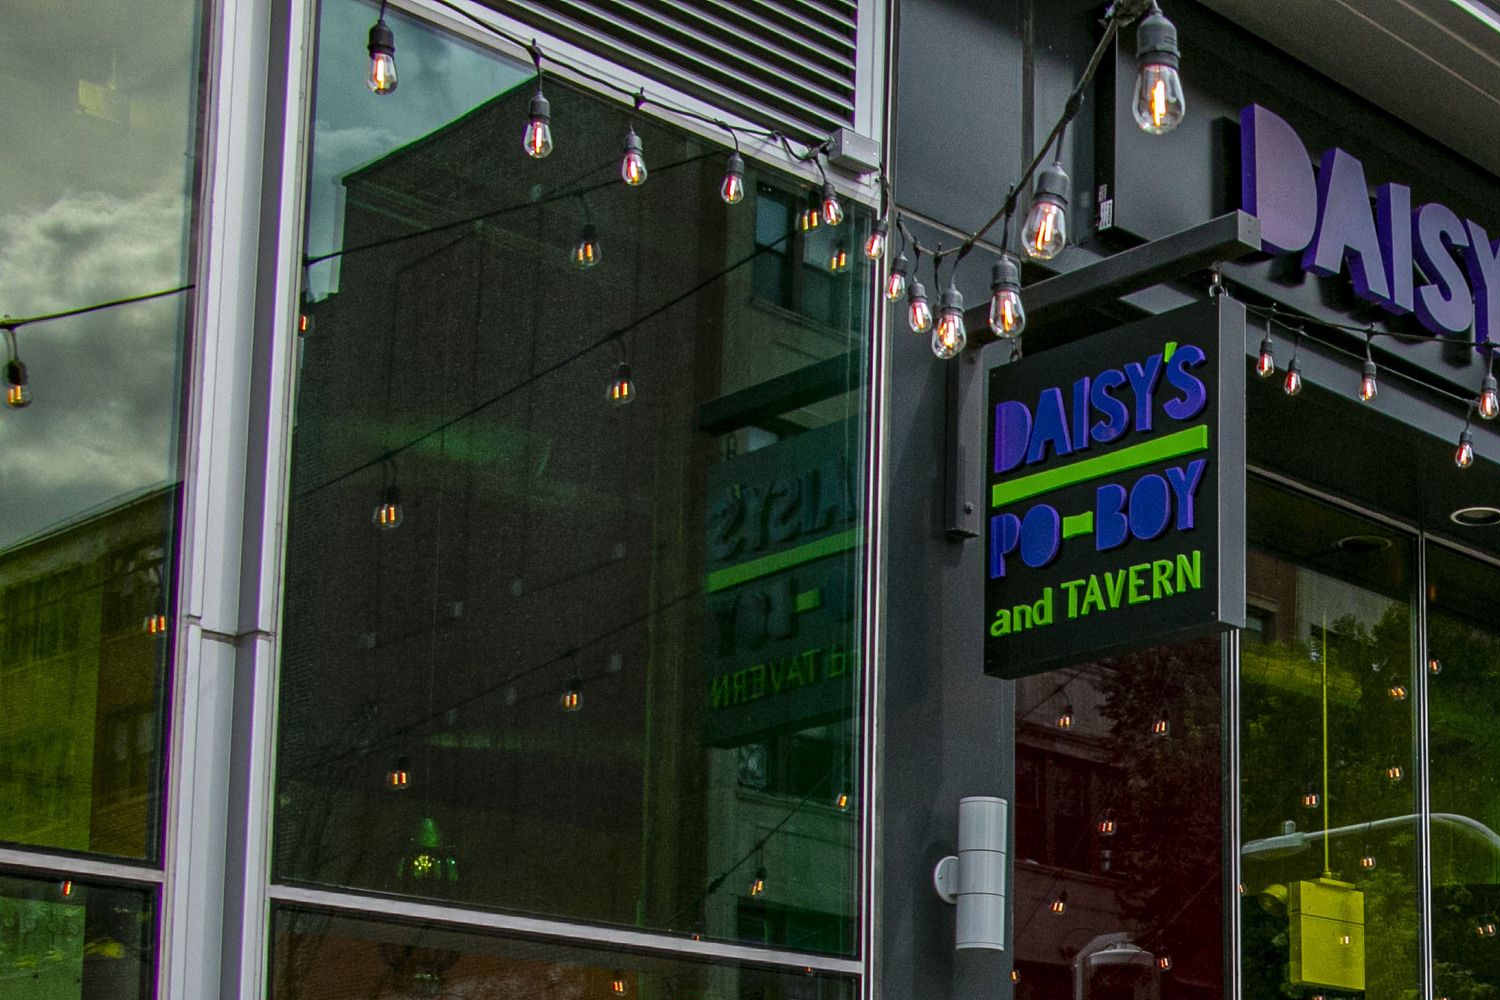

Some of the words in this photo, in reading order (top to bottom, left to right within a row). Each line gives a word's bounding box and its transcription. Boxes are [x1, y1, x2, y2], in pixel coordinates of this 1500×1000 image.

[993, 341, 1207, 474] DAISY'S
[989, 459, 1206, 579] PO-BOY
[990, 594, 1053, 637] and
[1061, 551, 1203, 620] TAVERN
